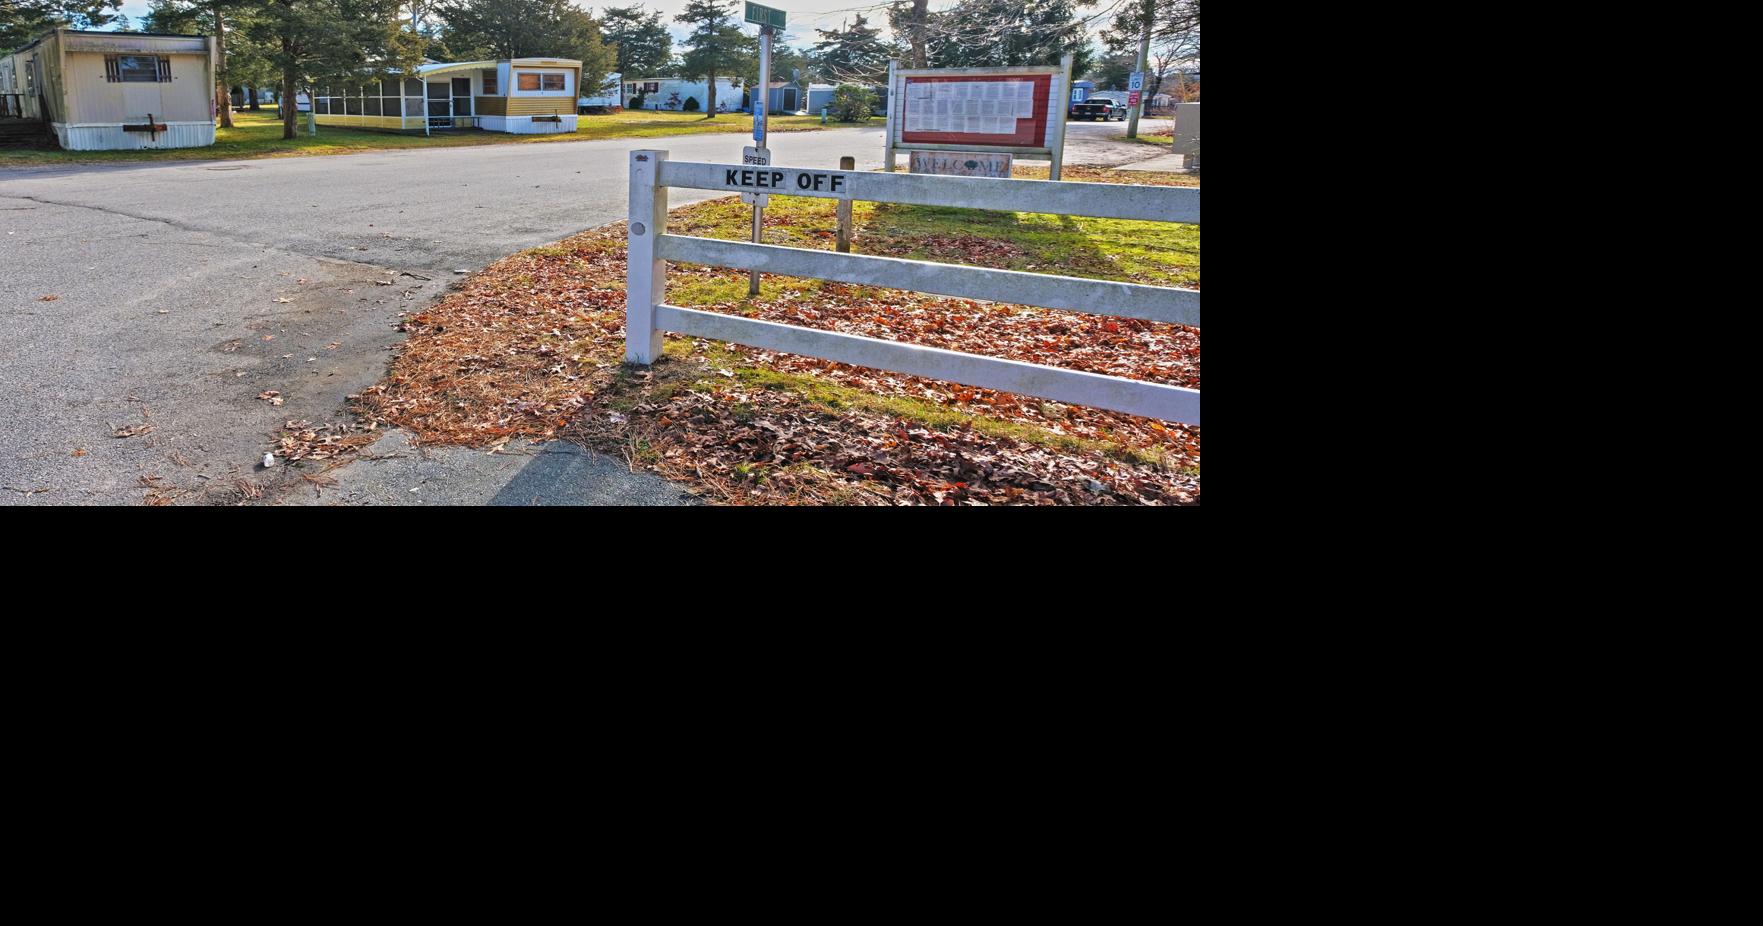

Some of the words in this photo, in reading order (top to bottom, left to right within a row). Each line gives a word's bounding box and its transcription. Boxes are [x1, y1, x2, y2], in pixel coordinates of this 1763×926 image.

[1131, 81, 1140, 89] 10
[744, 155, 767, 166] SPEED
[726, 169, 784, 188] KEEP
[797, 173, 845, 192] OFF
